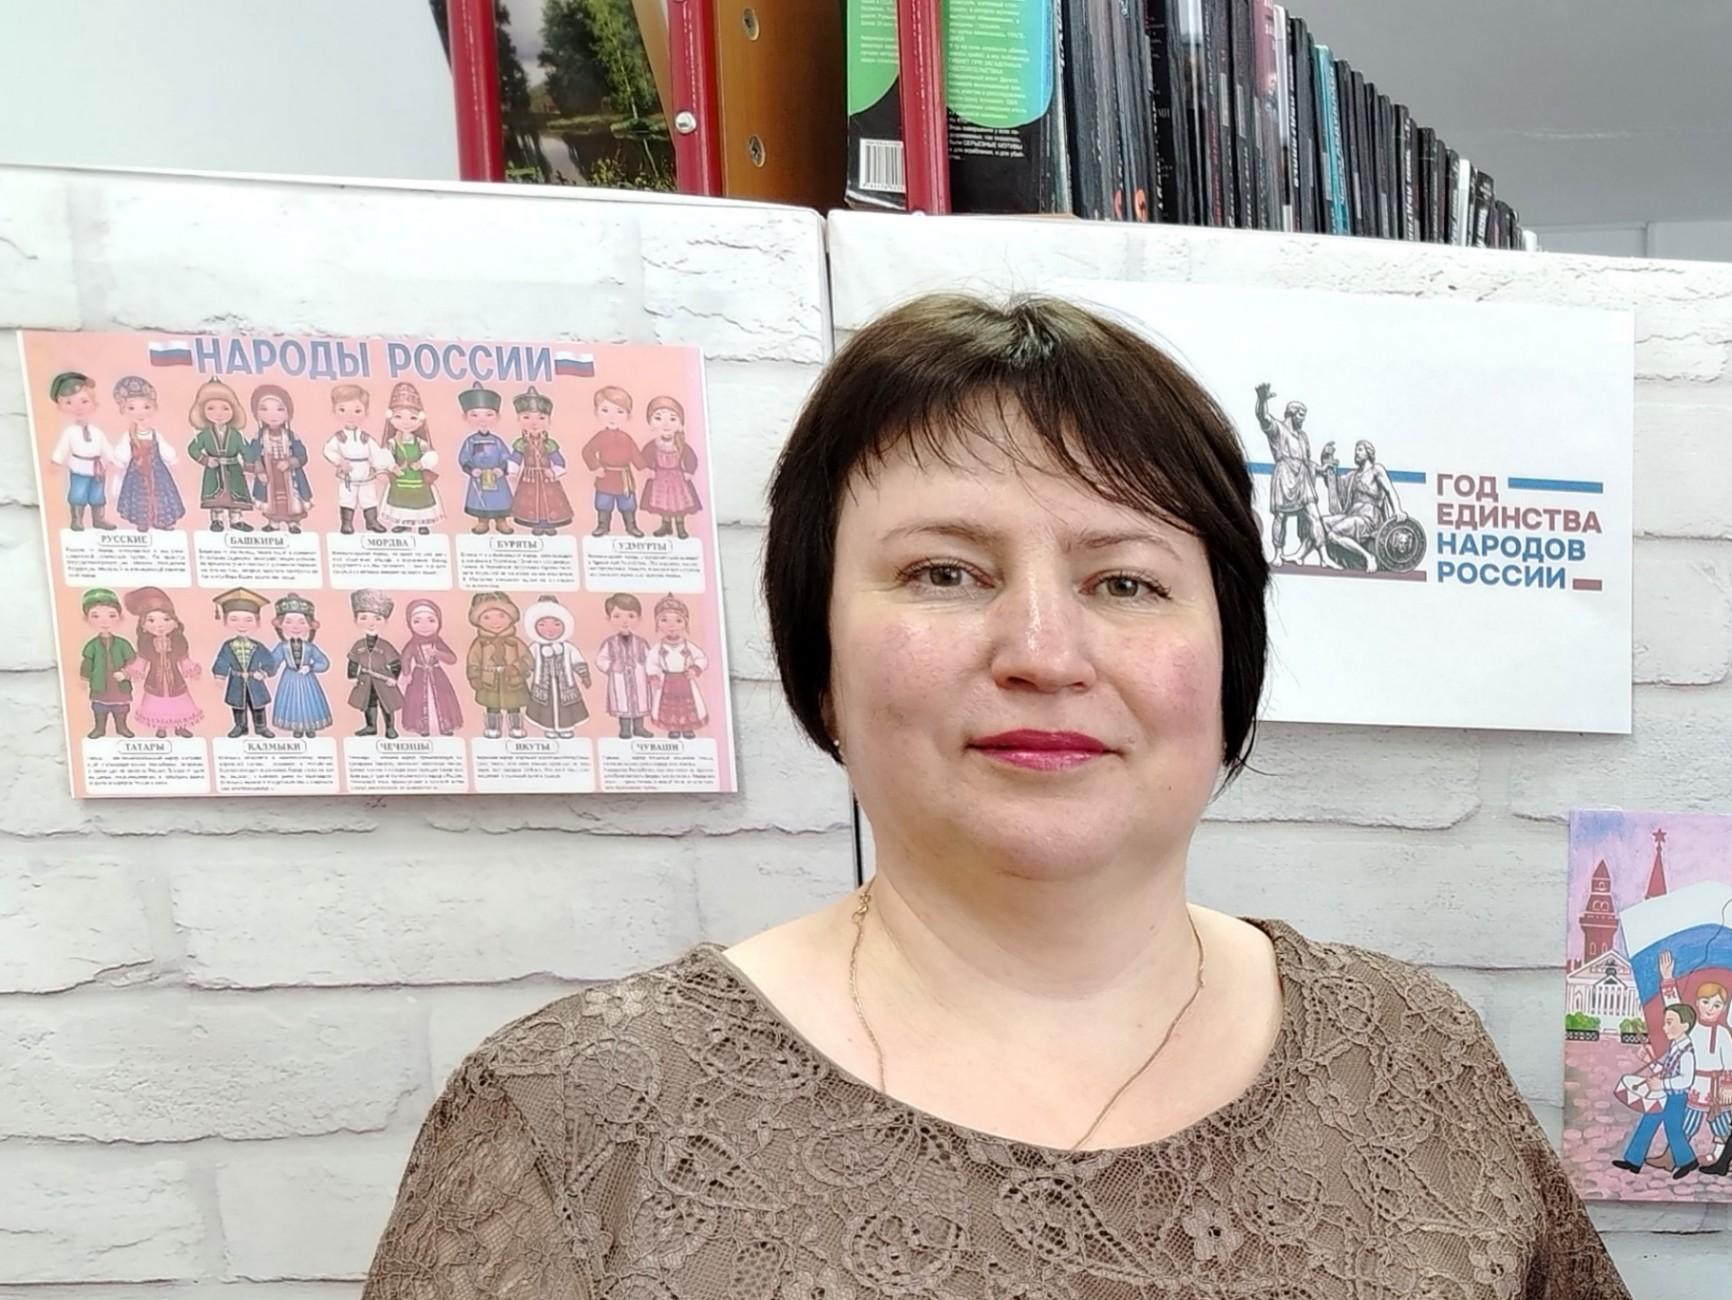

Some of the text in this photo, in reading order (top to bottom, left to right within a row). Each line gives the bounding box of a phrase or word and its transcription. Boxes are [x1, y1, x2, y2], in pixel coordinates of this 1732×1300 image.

[194, 337, 553, 382] НАРОДЫ РОССИИ
[1437, 473, 1499, 502] ГОД
[1437, 503, 1602, 533] ЕДИНСТВА
[101, 534, 148, 544] РУССКИЕ
[229, 536, 285, 546] БАШКИРЫ
[367, 538, 409, 548] МОРДВА
[497, 539, 538, 549] БУРЯТЫ
[618, 541, 667, 551] УДМУРТЫ
[1437, 533, 1586, 562] НАРОДОВ
[1437, 561, 1566, 589] РОССИИ
[124, 742, 166, 752] ТАТАРЫ
[247, 742, 301, 752] КАЛМЫКИ
[380, 742, 431, 752] ЧЕЧЕНЦЫ
[515, 743, 551, 752] ЯКУТЫ
[636, 743, 680, 752] ЧУВАШИ
